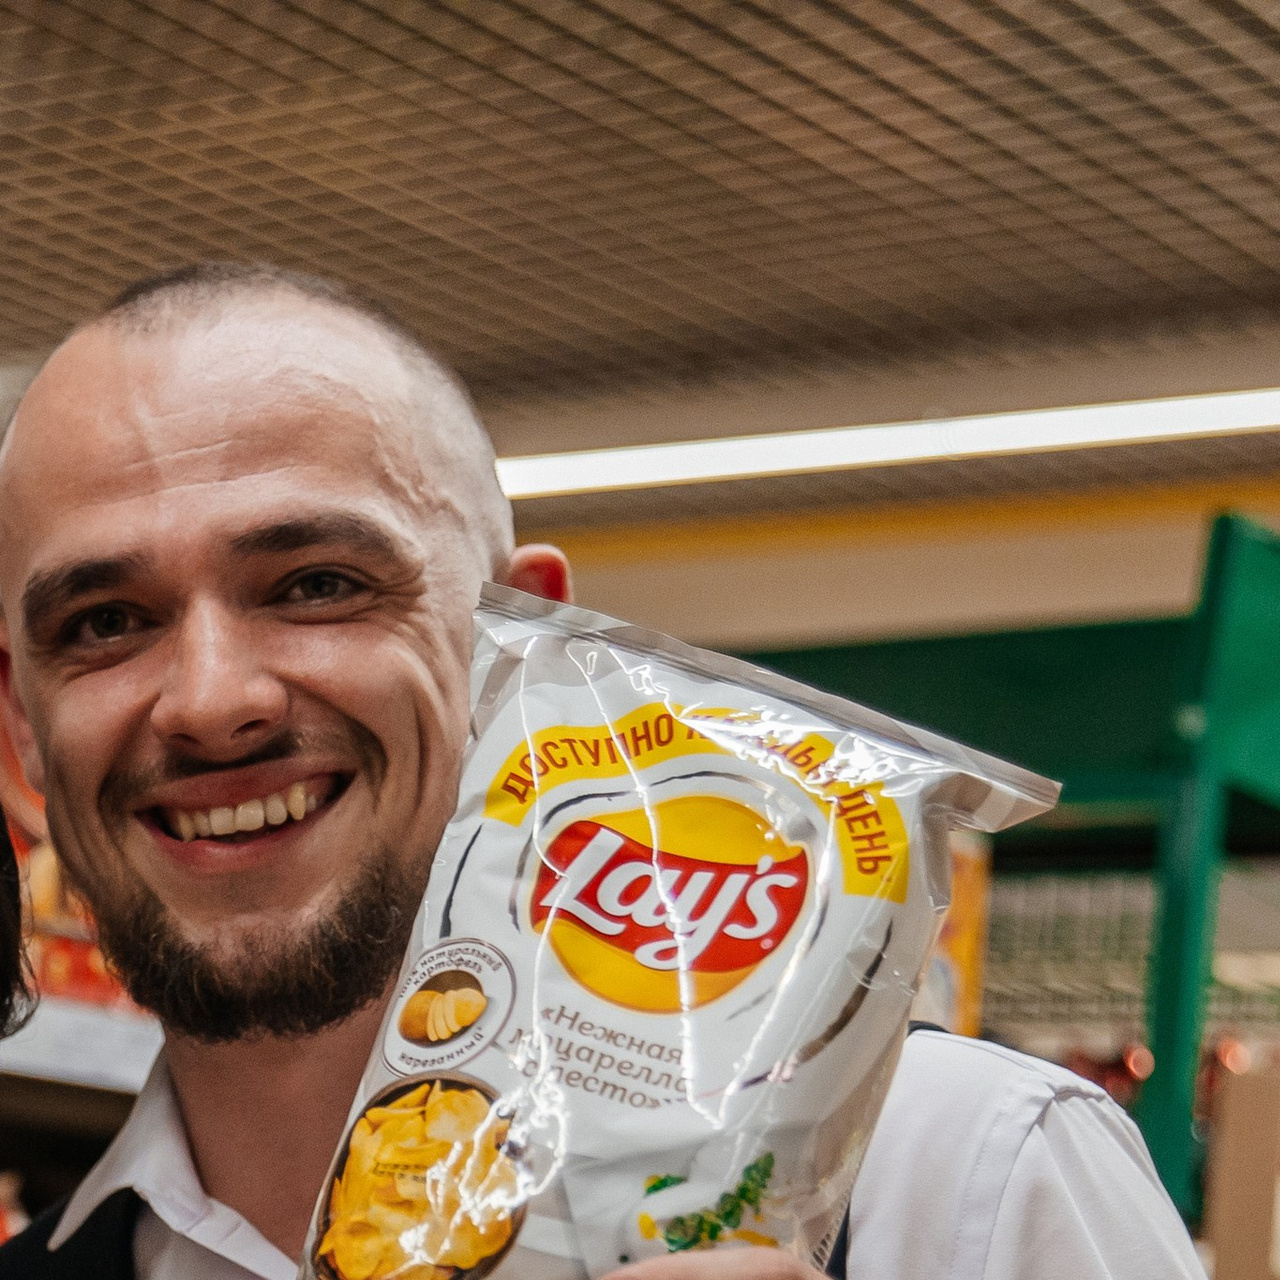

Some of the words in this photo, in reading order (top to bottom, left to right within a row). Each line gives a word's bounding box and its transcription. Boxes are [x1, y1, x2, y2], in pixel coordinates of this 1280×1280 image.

[501, 713, 675, 804] ДОСТУПНО
[826, 788, 892, 876] ДЕНЬ
[539, 827, 798, 970] Lay's
[509, 1028, 687, 1093] царелла
[540, 1004, 684, 1066] «Нежная
